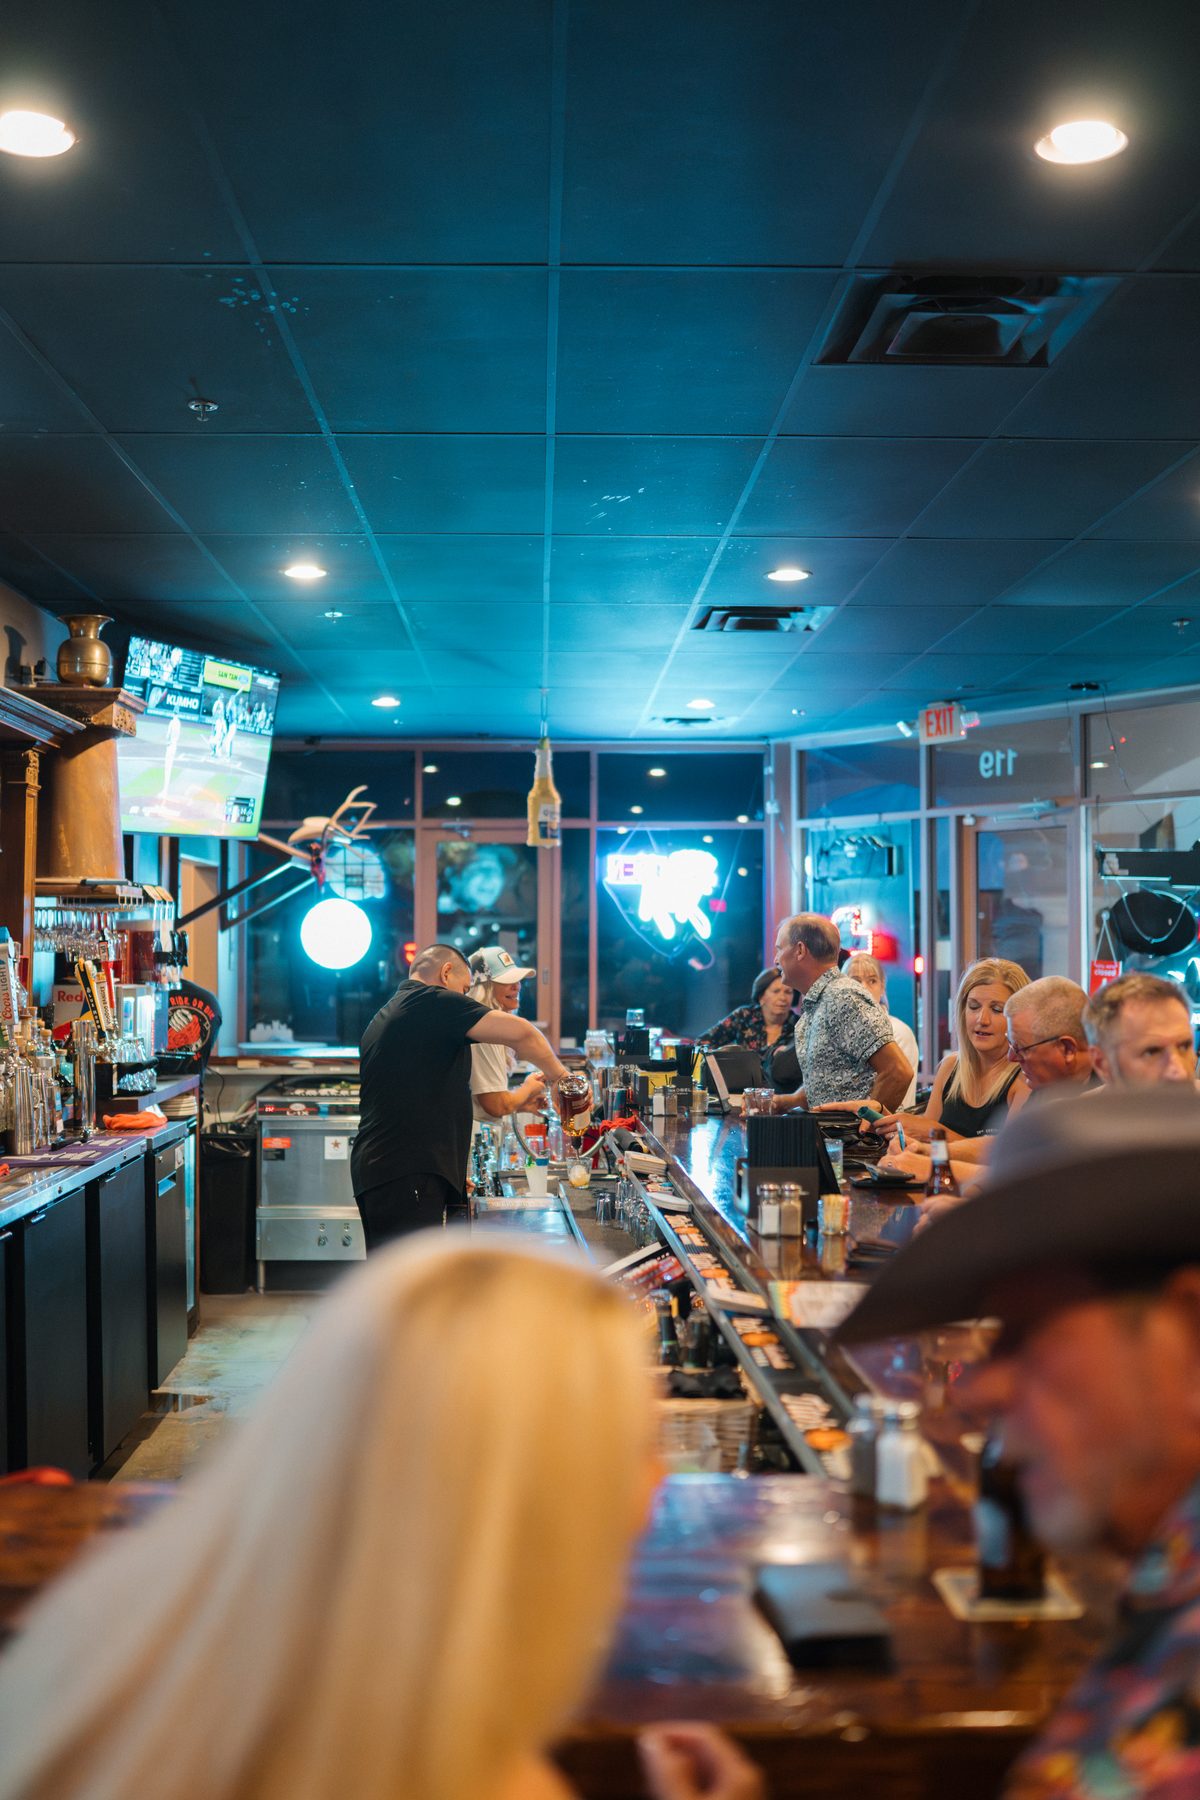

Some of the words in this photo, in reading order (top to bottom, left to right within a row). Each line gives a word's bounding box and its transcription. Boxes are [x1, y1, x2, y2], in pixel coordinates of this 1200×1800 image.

[166, 693, 199, 710] KUMHO
[925, 706, 954, 737] EXIT
[2, 992, 13, 1019] Coors
[57, 990, 83, 1002] Red
